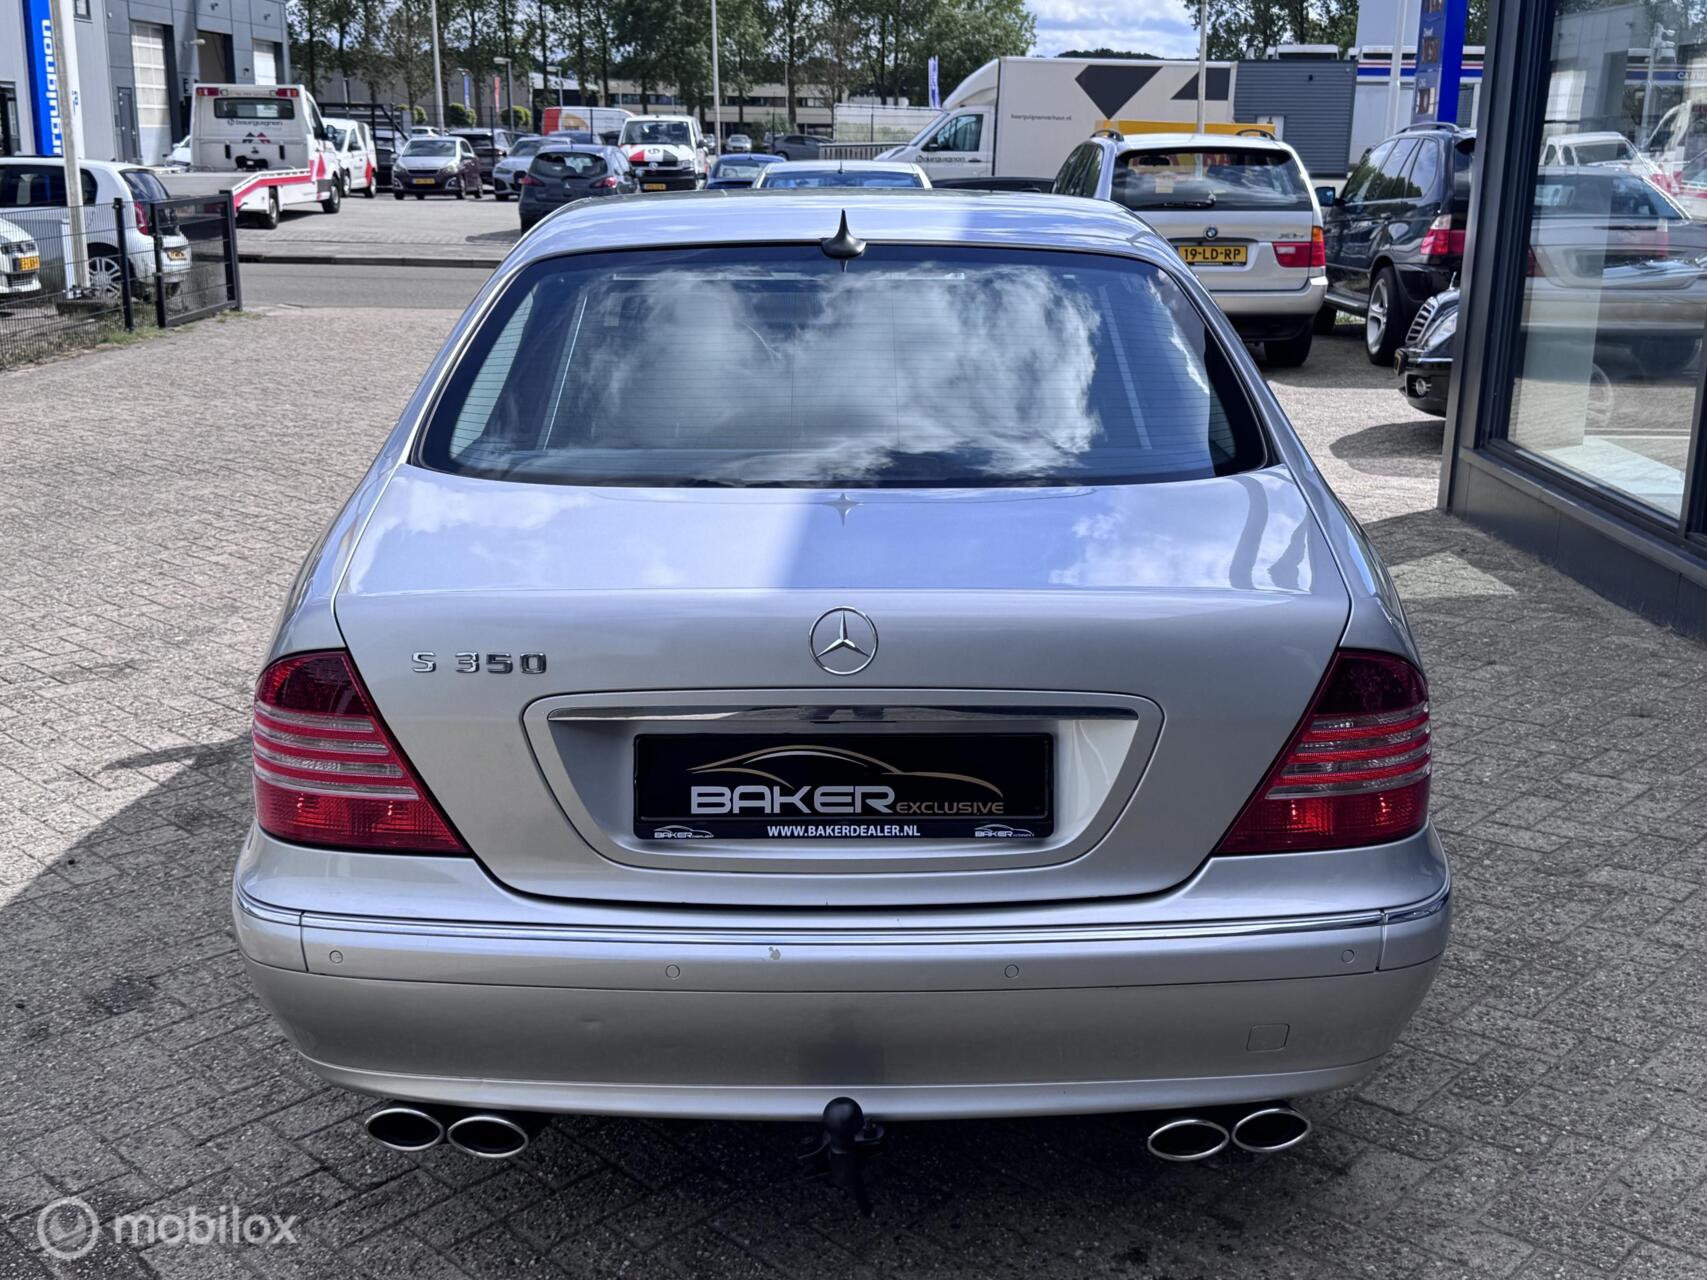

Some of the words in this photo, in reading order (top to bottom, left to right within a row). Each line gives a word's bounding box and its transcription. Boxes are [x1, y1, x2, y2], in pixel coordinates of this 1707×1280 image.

[1183, 248, 1241, 259] 19-LD-RP
[412, 651, 437, 673] S
[455, 651, 547, 674] 350
[690, 785, 895, 814] BAKER
[896, 801, 1004, 814] EXCLUSIVE
[654, 831, 693, 839] BAKER
[767, 824, 921, 837] WWW.BAKERDEALER.NL
[974, 830, 1013, 838] BAKER
